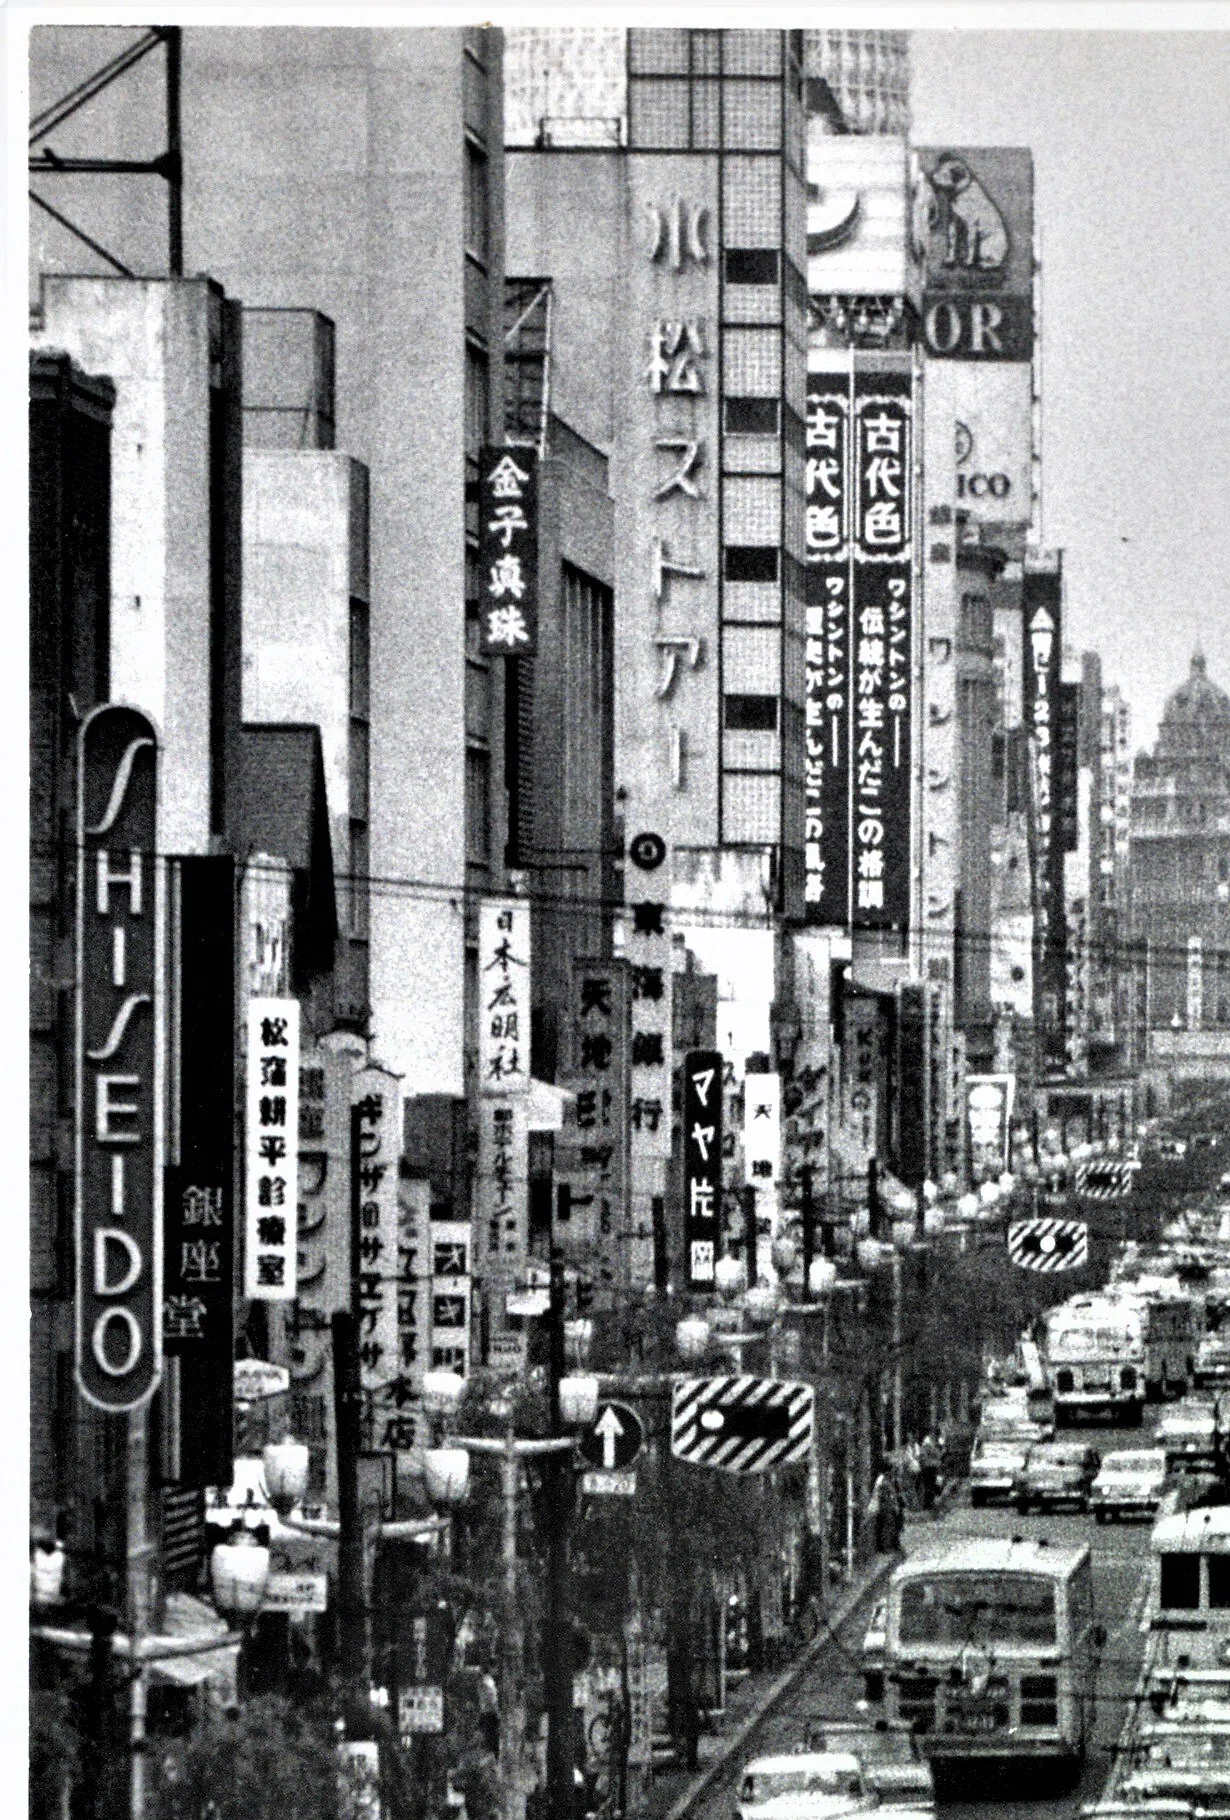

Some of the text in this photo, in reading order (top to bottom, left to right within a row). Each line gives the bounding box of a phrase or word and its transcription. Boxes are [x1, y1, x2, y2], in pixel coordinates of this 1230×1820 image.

[487, 455, 530, 644] 金子眞珠
[806, 408, 842, 548] 古代色
[864, 412, 902, 545] 古代色
[888, 579, 905, 710] ワシントンの
[86, 737, 153, 1377] SHISEIDO
[690, 1069, 714, 1279] マヤ片岡
